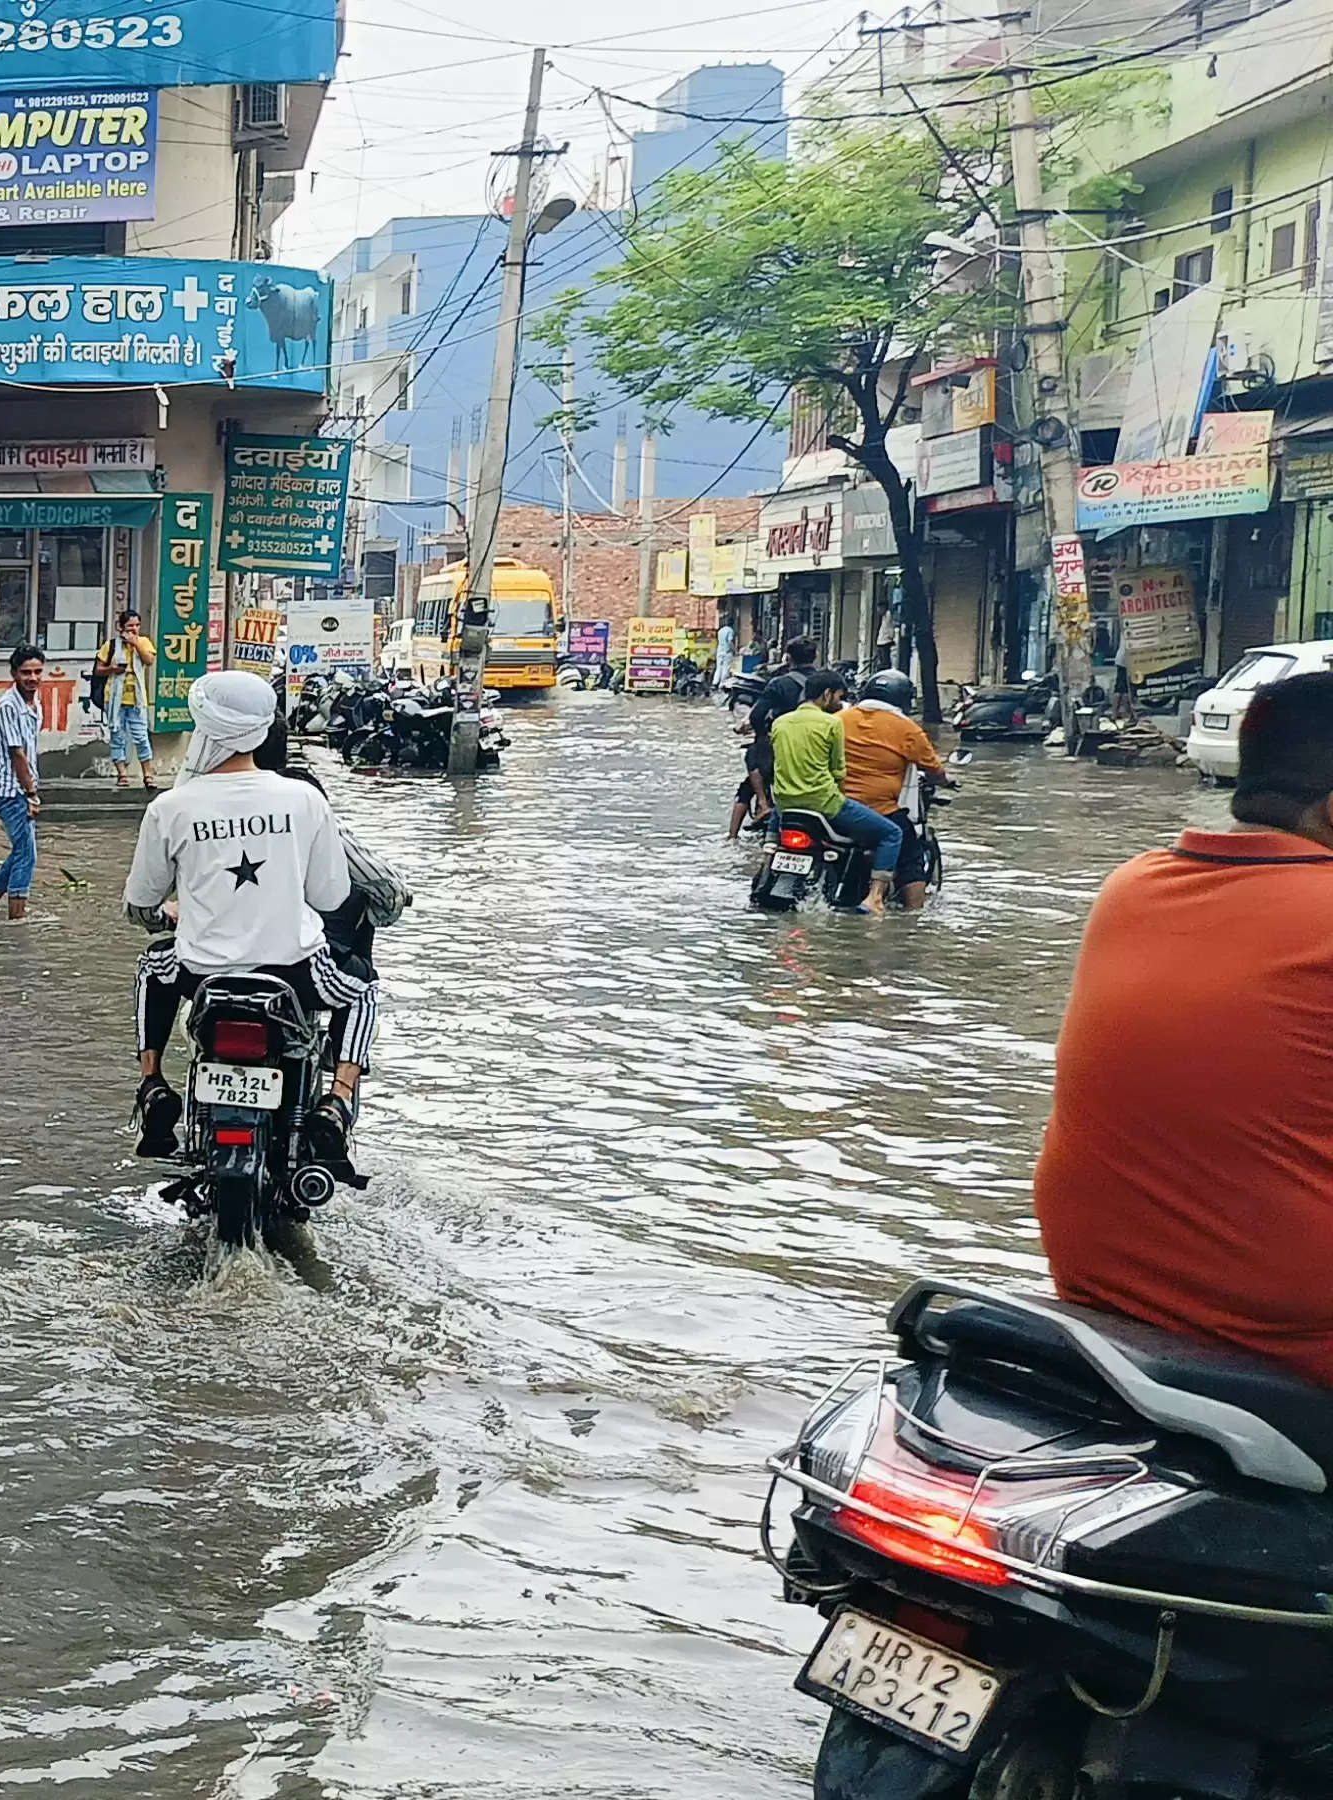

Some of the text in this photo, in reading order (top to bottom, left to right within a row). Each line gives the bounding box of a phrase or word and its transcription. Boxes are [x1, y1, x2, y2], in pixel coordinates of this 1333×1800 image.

[21, 151, 150, 176] LAPTOP
[23, 180, 102, 201] Available
[106, 178, 148, 197] Here
[18, 204, 88, 223] Repair
[80, 285, 167, 323] हाल
[43, 332, 67, 364] की
[133, 332, 182, 365] मिलती
[233, 441, 346, 472] दवाईयाँ
[315, 479, 342, 495] हाल
[1141, 472, 1248, 497] MOBILE
[21, 502, 113, 524] MEDICINES
[247, 539, 314, 556] 9355280523
[207, 1071, 271, 1093] HR 12L
[216, 1088, 259, 1105] 7823
